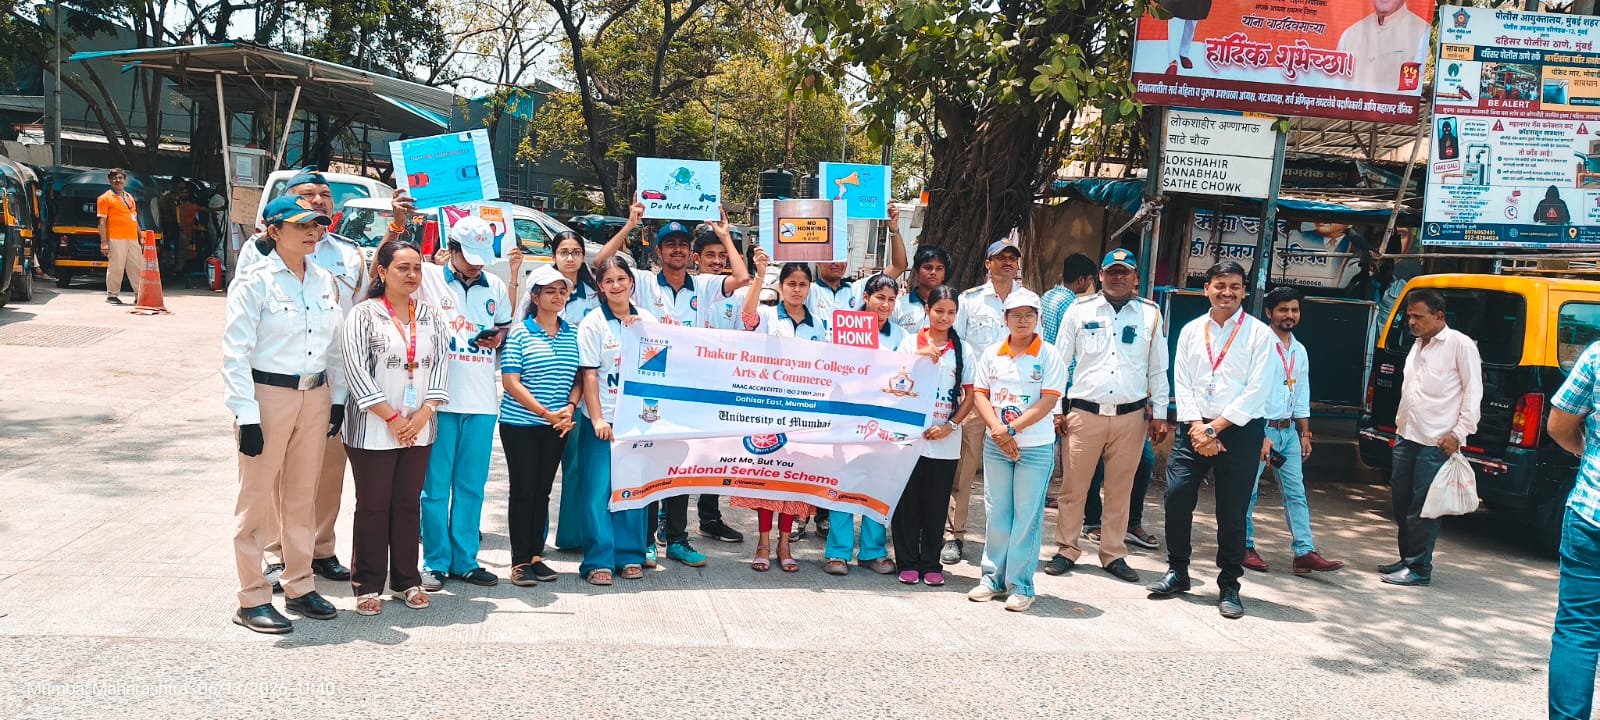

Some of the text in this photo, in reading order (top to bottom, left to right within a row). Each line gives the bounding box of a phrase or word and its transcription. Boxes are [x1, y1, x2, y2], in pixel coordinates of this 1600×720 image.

[1495, 11, 1518, 22] पोलीस
[1566, 16, 1583, 28] मुंबई
[1495, 35, 1521, 46] दहिसर
[1523, 37, 1550, 48] पोलीस
[1575, 41, 1593, 51] मुंबई
[1206, 34, 1353, 80] हार्दिक शुभेच्छा!
[1488, 99, 1531, 109] BE ALERT
[1170, 114, 1262, 134] लोकशाहीर अण्णाभाऊ
[1168, 132, 1211, 146] साठे चौक
[1166, 155, 1229, 168] LOKSHAHIR
[1164, 167, 1227, 180] ANNABHAU
[1163, 178, 1242, 193] SATHE CHOWK
[665, 202, 681, 210] Not
[837, 314, 873, 330] DON'T
[837, 331, 873, 345] HONK
[695, 345, 738, 361] Thakur
[815, 359, 856, 377] College
[858, 364, 872, 376] of
[732, 366, 833, 387] Arts & Commerce
[748, 385, 783, 394] ACCREDITED
[736, 395, 817, 409] Dahisar East, Mumbai
[718, 409, 832, 429] University of Mumbai
[739, 457, 755, 466] Me,
[757, 457, 774, 466] But
[776, 459, 794, 468] You
[668, 465, 839, 486] National Service Scheme
